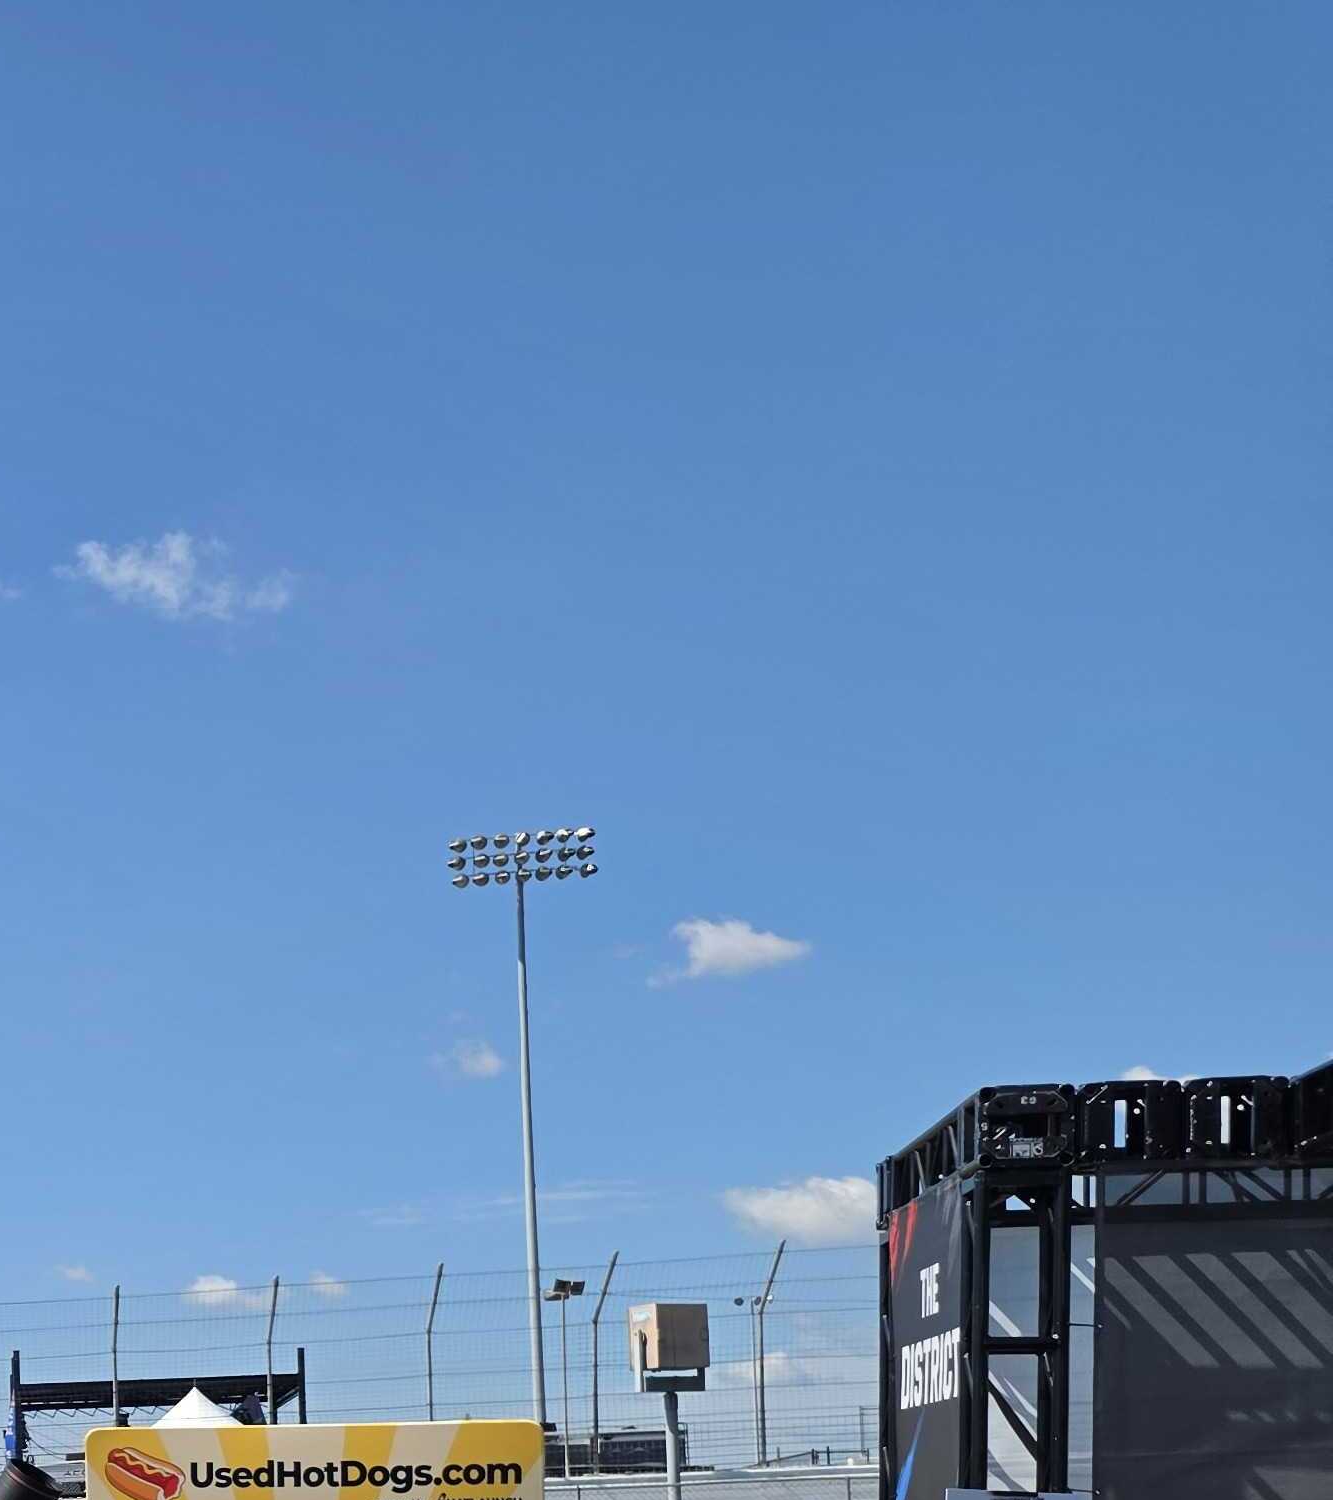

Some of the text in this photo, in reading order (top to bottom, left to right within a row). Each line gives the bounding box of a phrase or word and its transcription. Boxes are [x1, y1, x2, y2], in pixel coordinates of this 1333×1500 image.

[920, 1262, 940, 1319] THE
[900, 1327, 961, 1410] DISTRICT
[190, 1460, 522, 1493] UsedHotDogs.com
